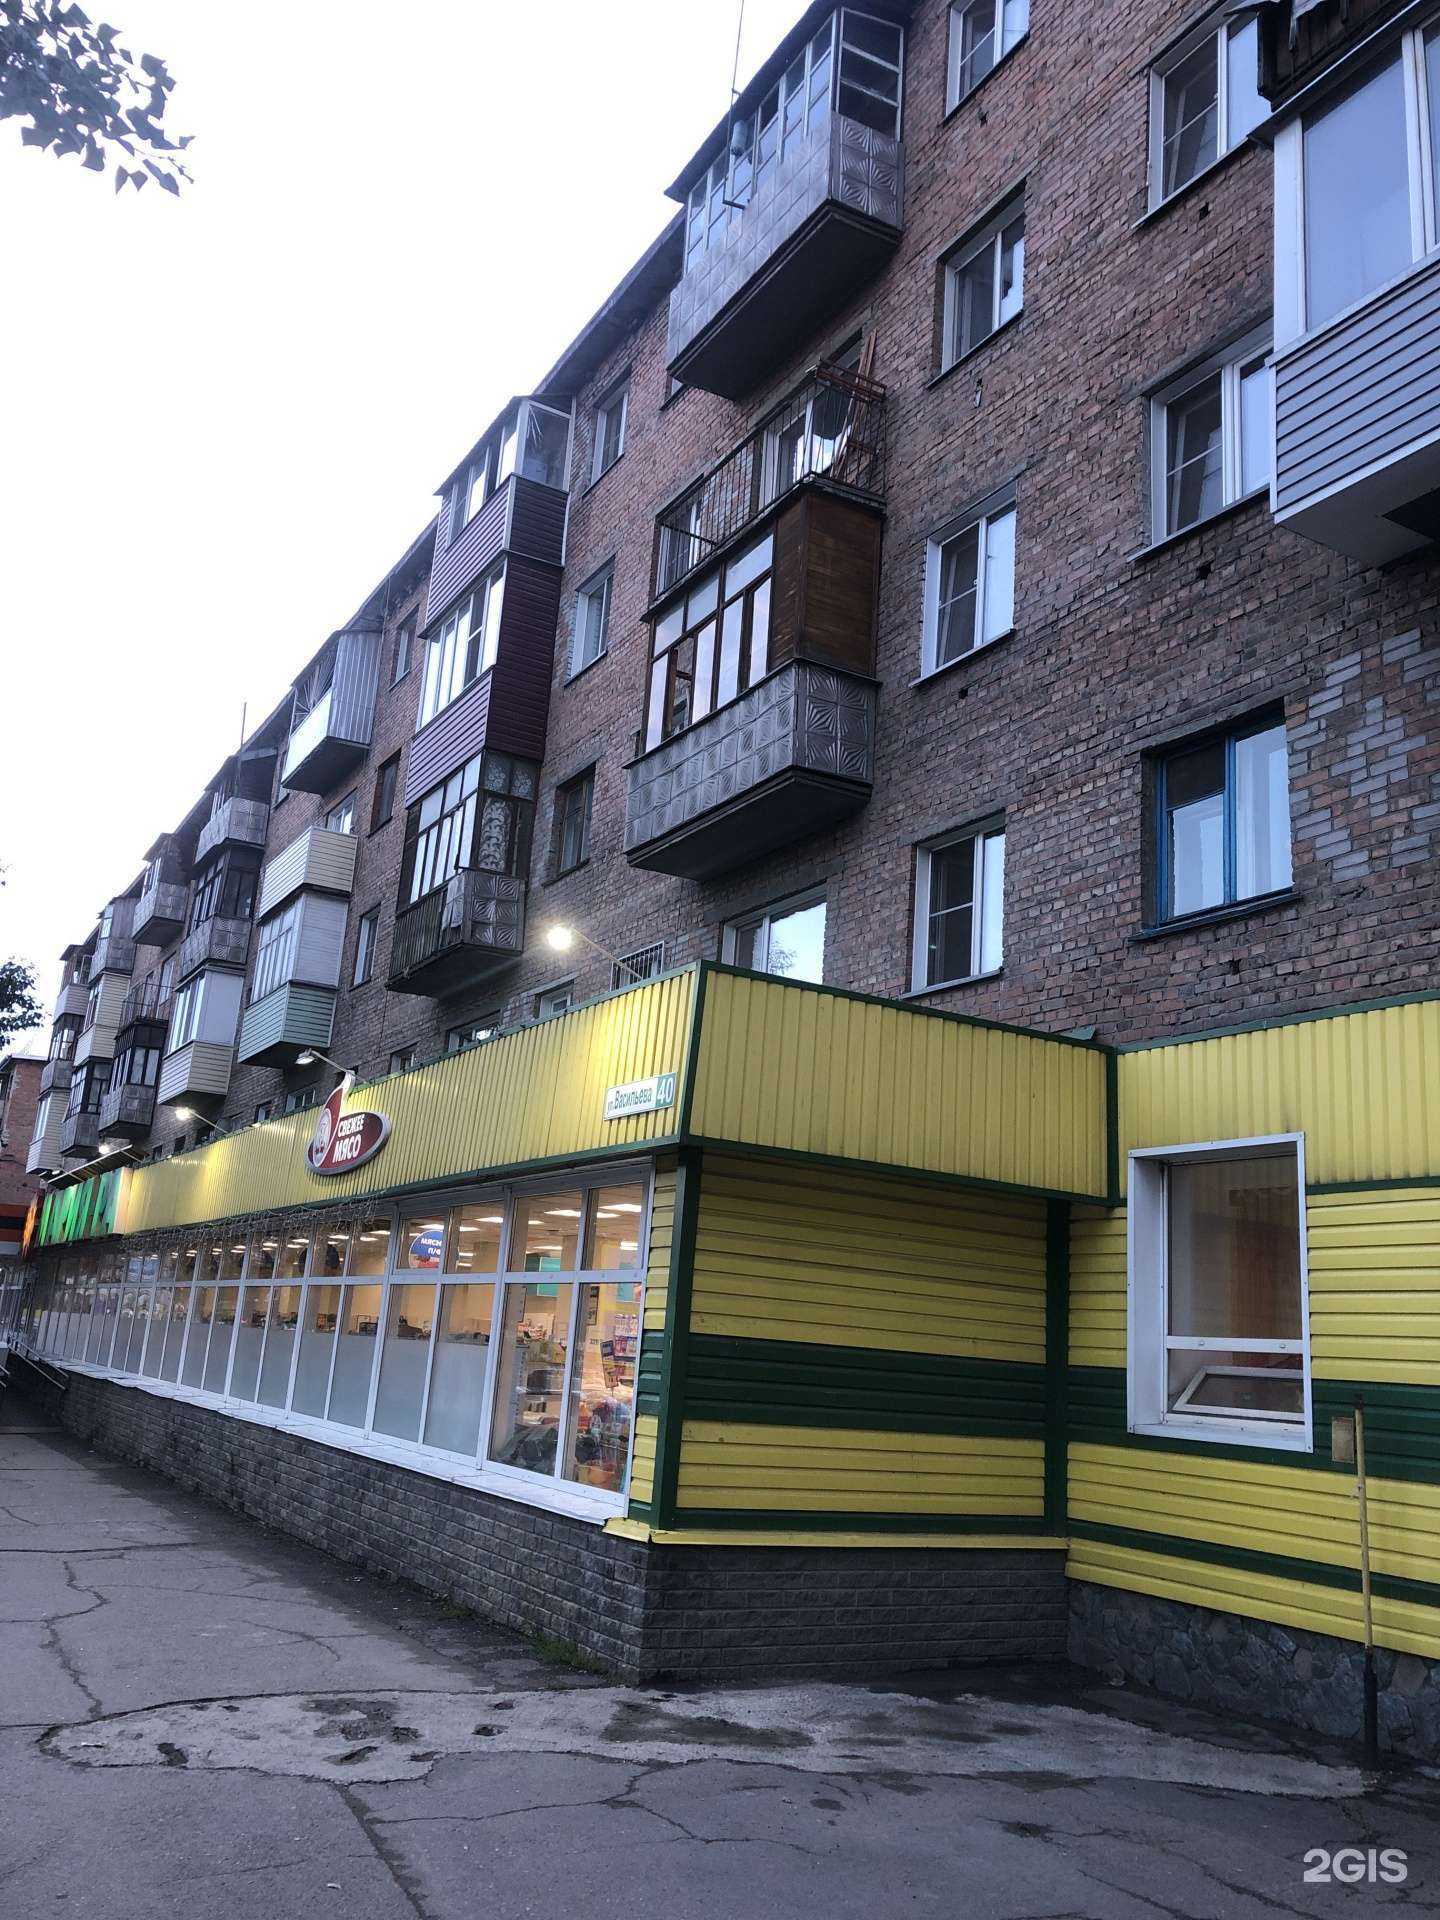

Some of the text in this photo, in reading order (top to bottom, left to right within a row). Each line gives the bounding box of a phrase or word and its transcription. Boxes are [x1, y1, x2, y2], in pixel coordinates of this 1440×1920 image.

[614, 1088, 653, 1110] Васильева
[657, 1077, 674, 1104] 40
[338, 1114, 365, 1138] СВЕЖЕЕ
[332, 1133, 361, 1163] МЯСО
